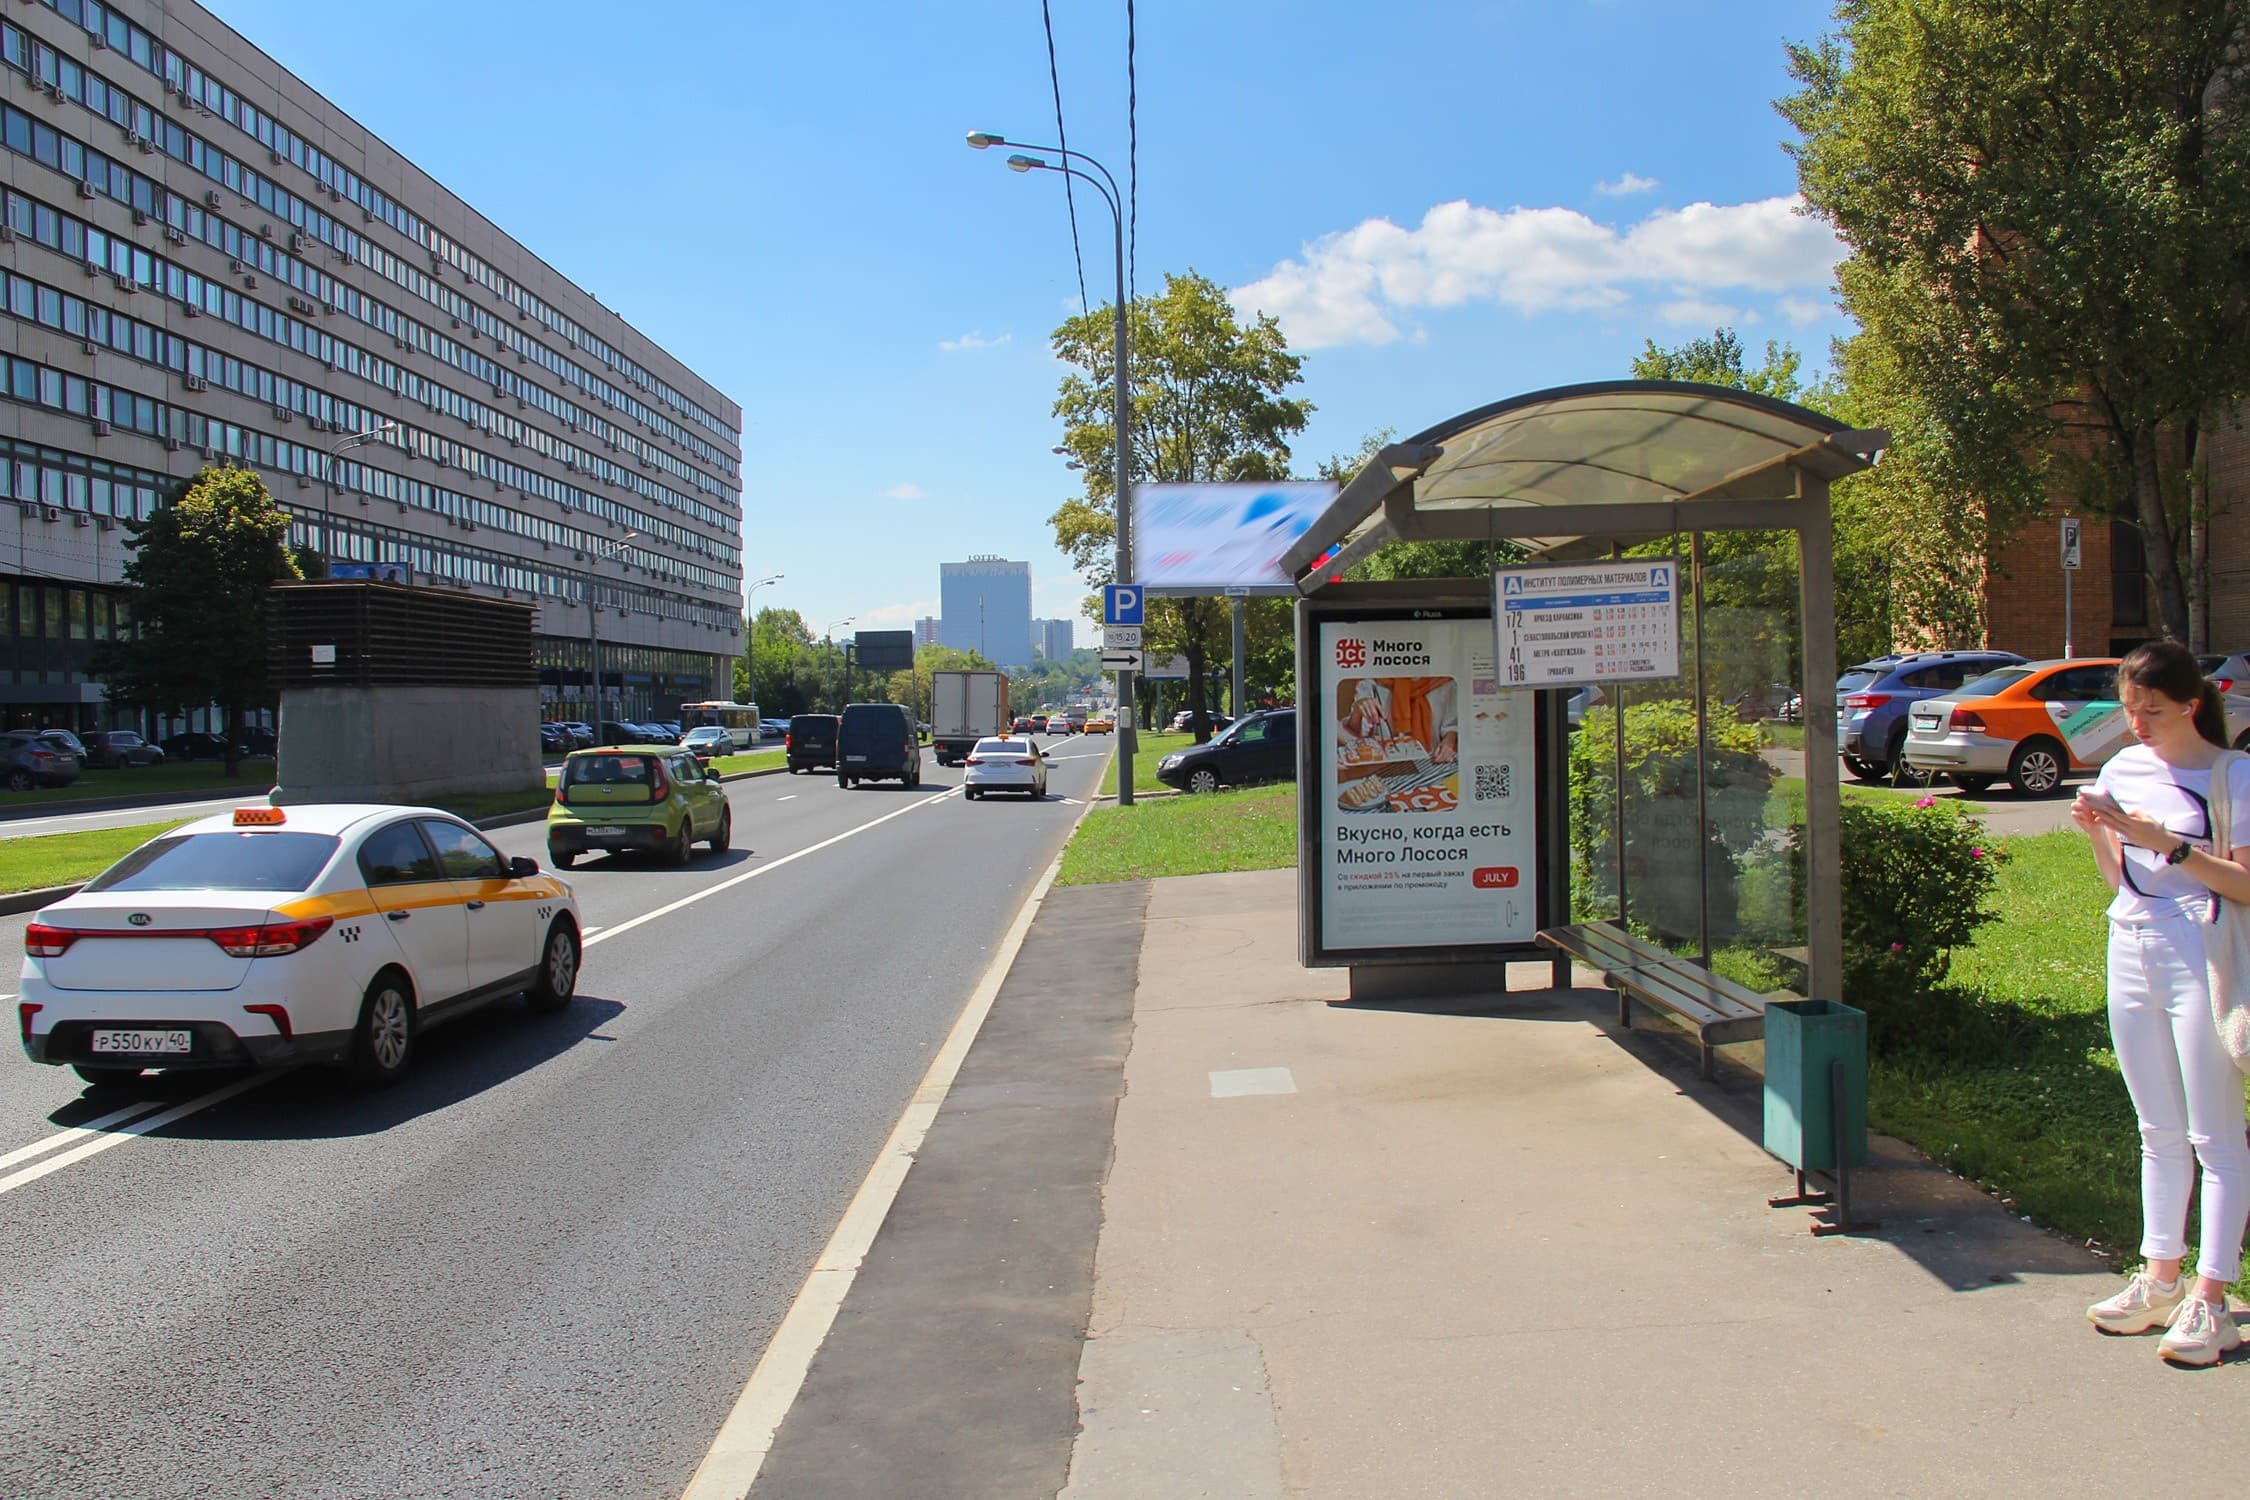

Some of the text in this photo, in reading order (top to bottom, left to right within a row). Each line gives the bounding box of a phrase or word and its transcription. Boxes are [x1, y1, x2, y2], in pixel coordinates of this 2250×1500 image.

[1524, 572, 1647, 588] ИНСТИТУТ ПОЛИМЕРНЫХ МАТЕРИАЛОВ
[1115, 589, 1136, 620] P
[1125, 632, 1136, 641] 20
[1373, 640, 1422, 652] Много
[1373, 655, 1430, 666] лосося
[1510, 647, 1520, 663] 41
[1508, 664, 1525, 681] 196
[1337, 824, 1512, 844] Вкусно, когда есть
[1337, 846, 1468, 864] Много Лосося
[1482, 872, 1509, 883] JULY
